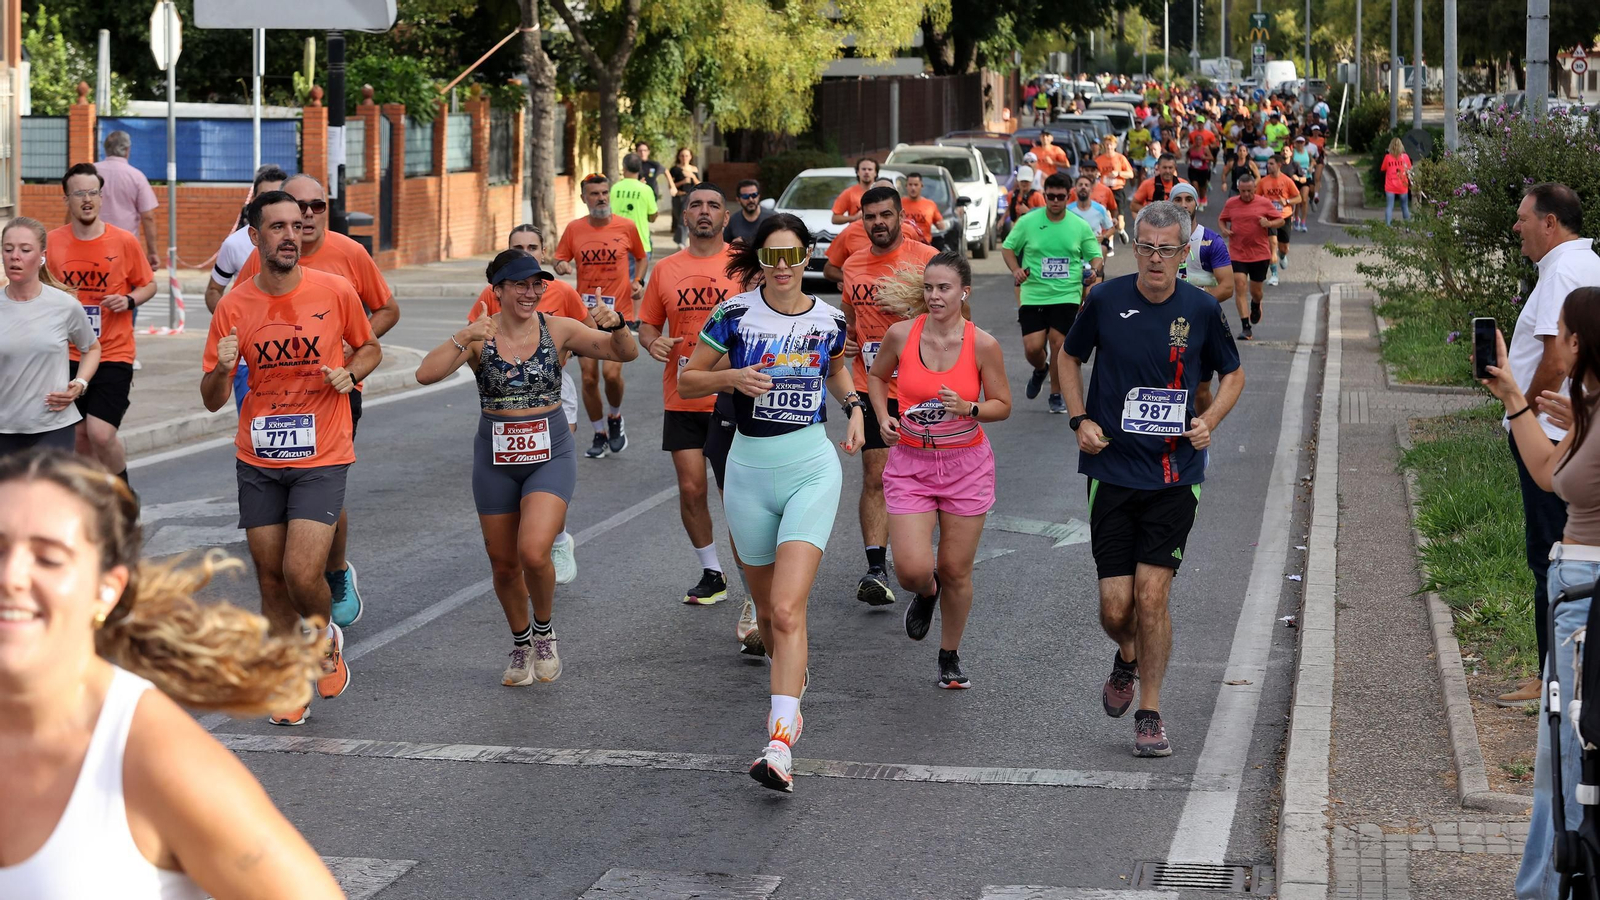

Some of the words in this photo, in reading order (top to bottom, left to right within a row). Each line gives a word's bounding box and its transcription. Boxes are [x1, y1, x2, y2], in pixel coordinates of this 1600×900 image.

[617, 190, 640, 199] STAFF
[767, 392, 812, 409] 1085
[1139, 403, 1171, 420] 987
[267, 430, 297, 446] 771
[506, 435, 536, 450] 286
